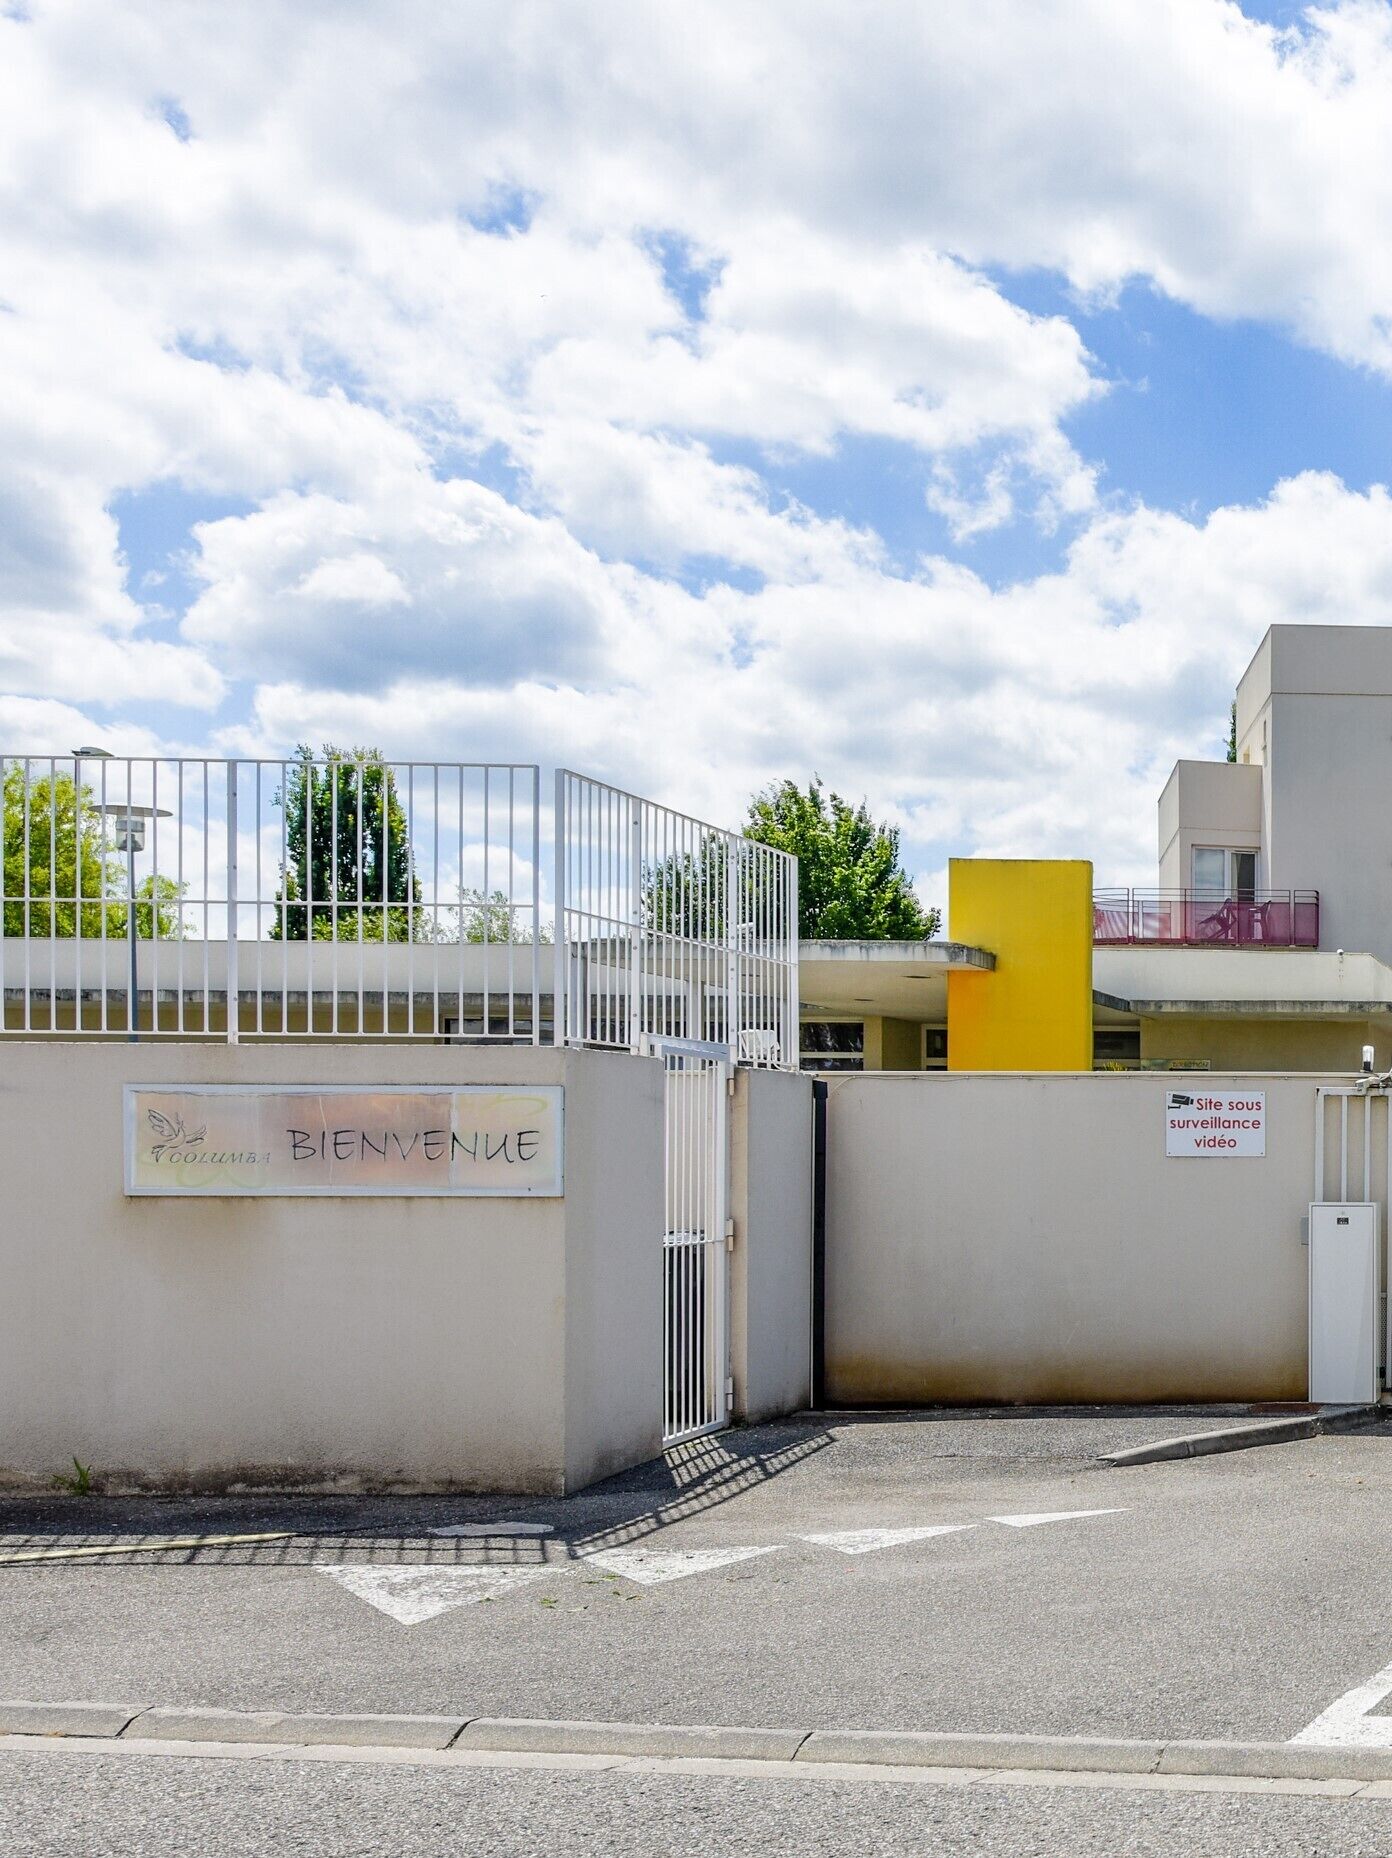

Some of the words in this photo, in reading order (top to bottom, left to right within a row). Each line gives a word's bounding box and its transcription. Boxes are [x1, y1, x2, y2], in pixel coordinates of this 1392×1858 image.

[1196, 1098, 1223, 1110] Site
[1228, 1101, 1262, 1111] sous
[1170, 1116, 1261, 1129] surveillance
[286, 1129, 540, 1164] BIENVENUE
[1194, 1134, 1237, 1148] vidéo
[169, 1151, 271, 1164] COLUMBA
